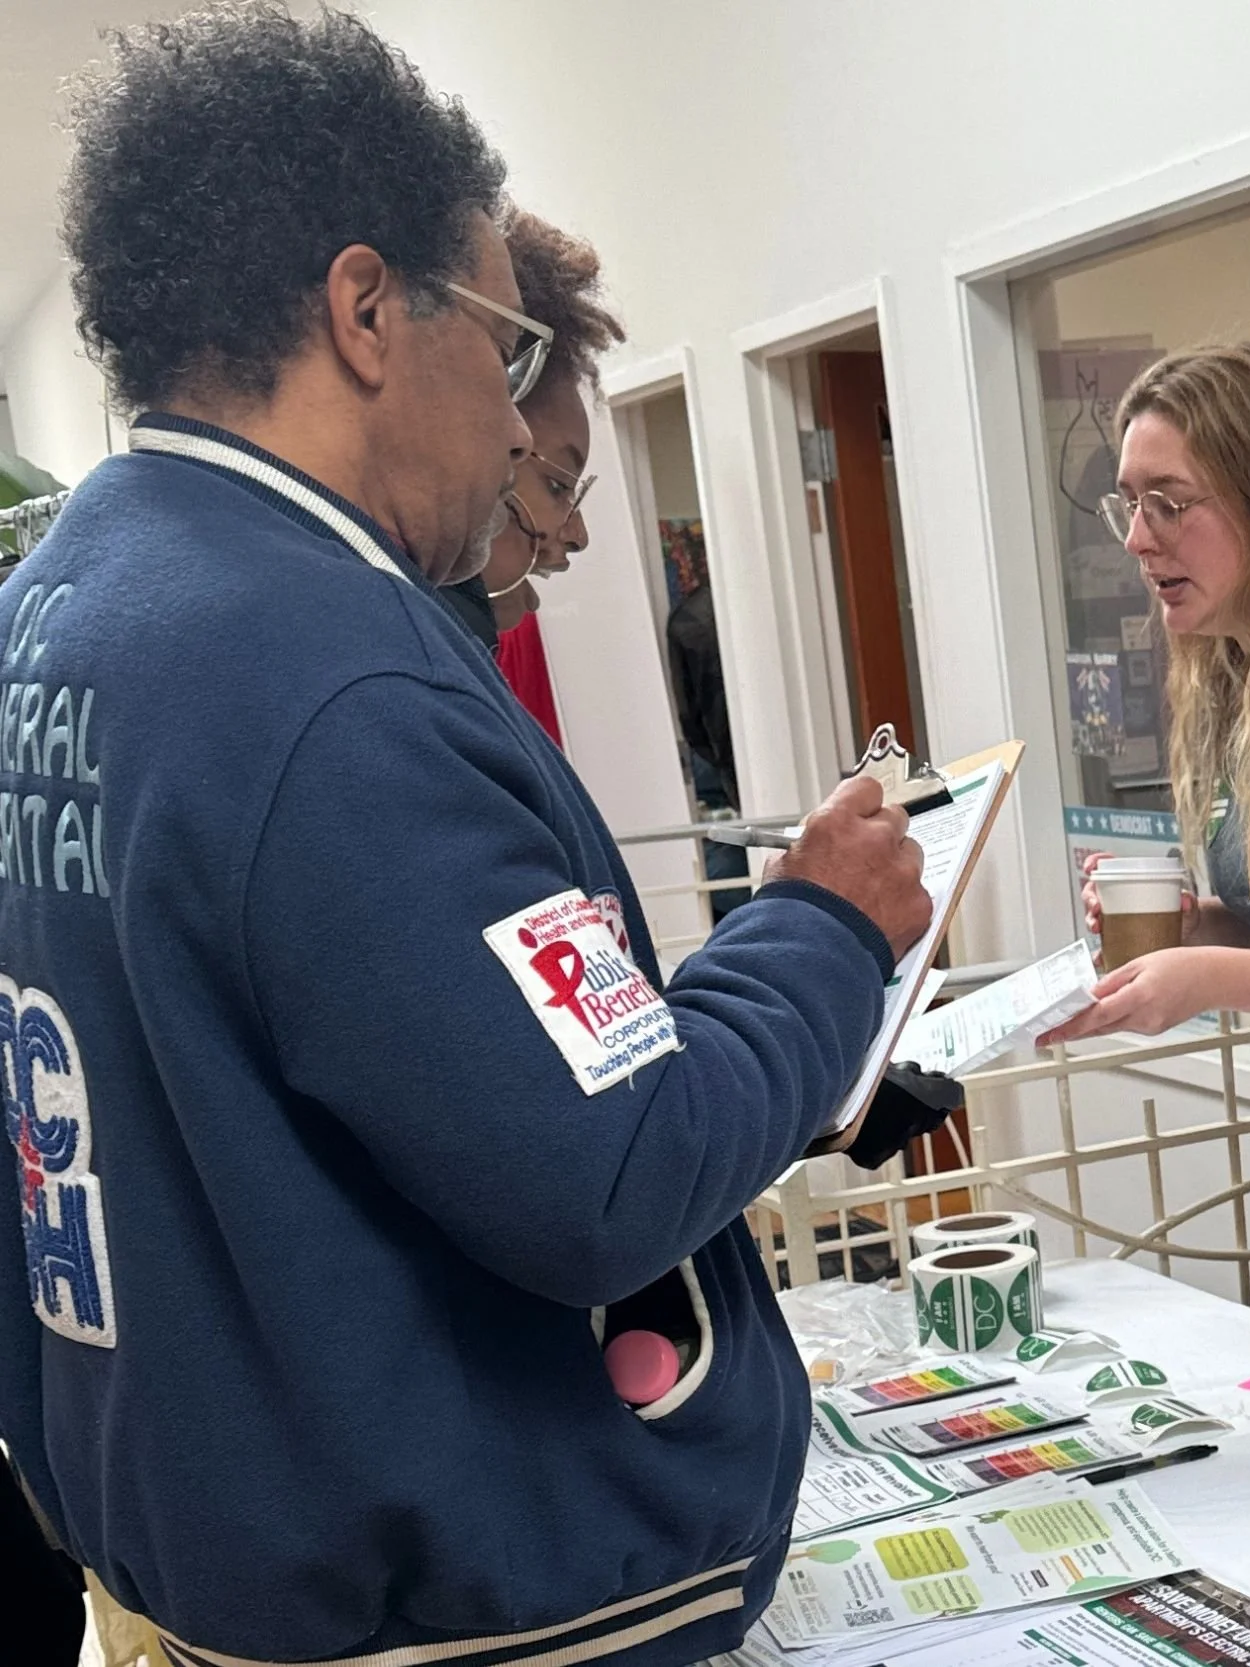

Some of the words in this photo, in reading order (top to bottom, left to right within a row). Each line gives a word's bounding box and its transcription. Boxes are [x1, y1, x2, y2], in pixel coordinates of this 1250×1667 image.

[6, 583, 74, 667] DC
[584, 1048, 632, 1080] Touching
[627, 1033, 658, 1058] People
[973, 1292, 998, 1331] DC
[1133, 1594, 1207, 1636] APARTMENT'S
[1149, 1584, 1196, 1614] SAVE
[1190, 1603, 1243, 1635] MONEY
